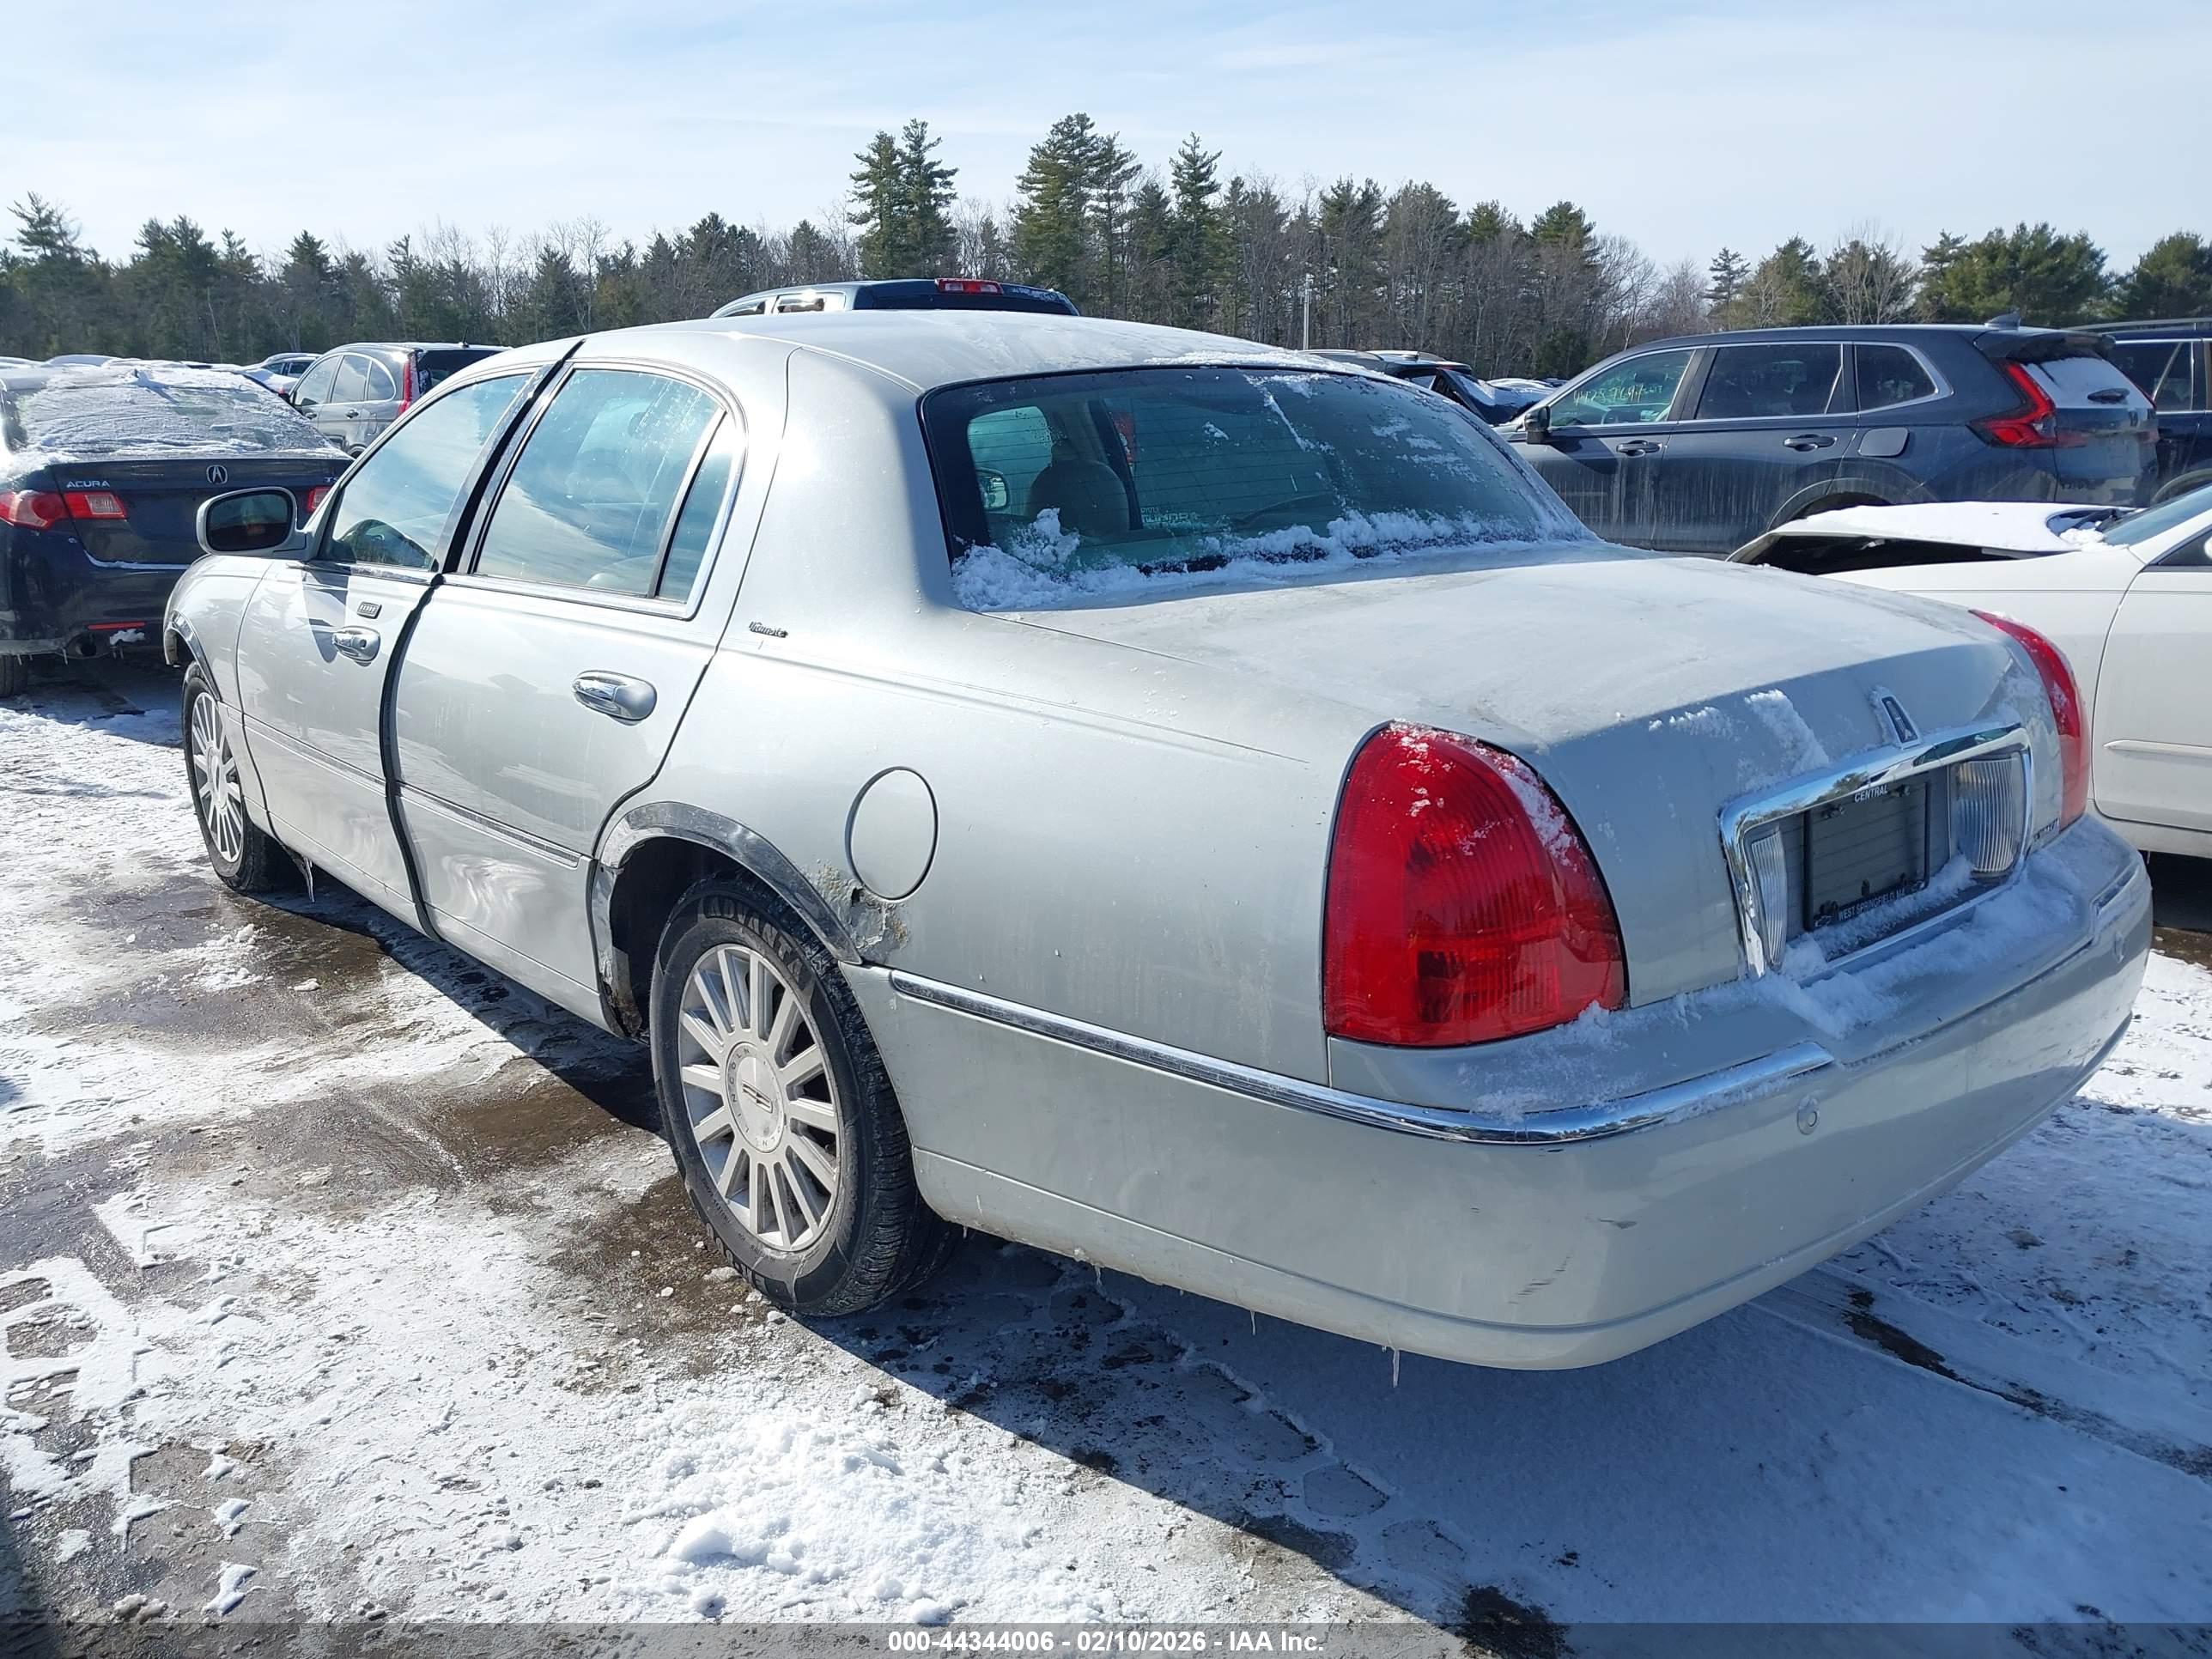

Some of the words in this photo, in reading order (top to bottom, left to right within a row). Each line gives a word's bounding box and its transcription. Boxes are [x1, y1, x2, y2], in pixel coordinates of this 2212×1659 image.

[66, 480, 111, 489] ACURA
[1854, 784, 1888, 803] CENTRAL
[1838, 905, 1856, 921] WEST
[706, 896, 804, 983] ADVANTA
[729, 1048, 750, 1133] LINCOLN
